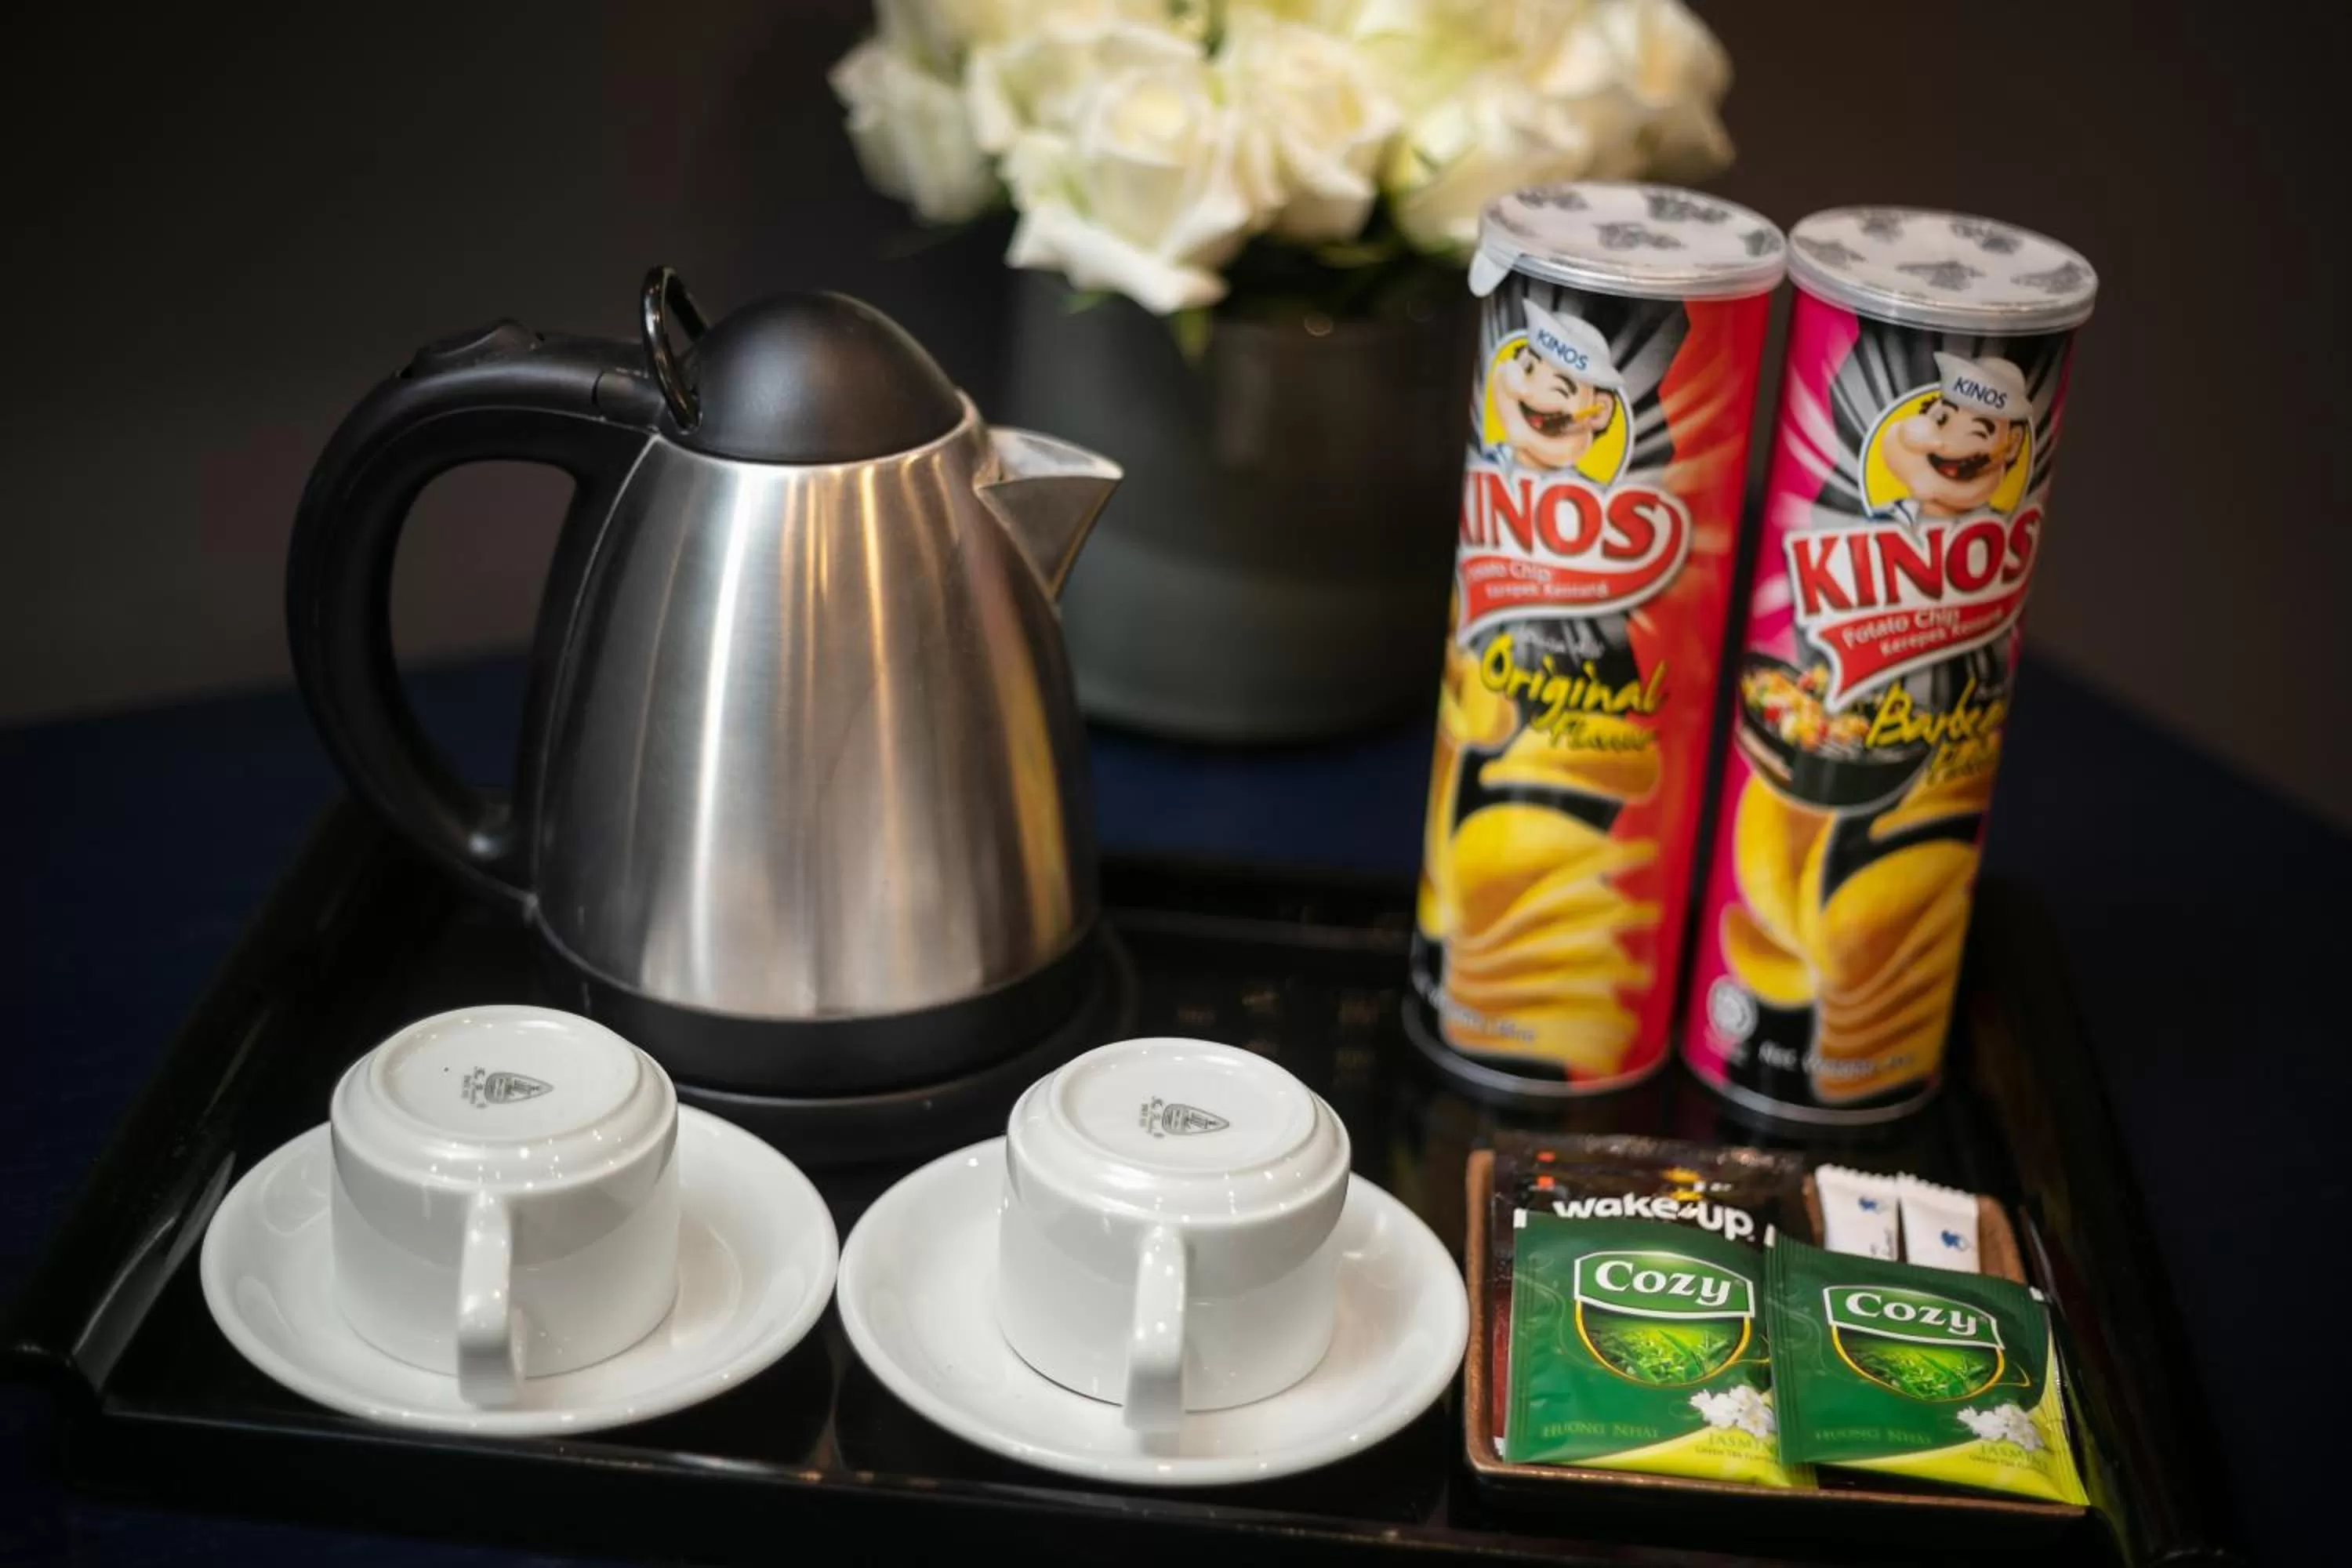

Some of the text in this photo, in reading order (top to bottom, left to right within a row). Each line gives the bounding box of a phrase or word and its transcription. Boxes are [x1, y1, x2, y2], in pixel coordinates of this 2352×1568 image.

[1536, 327, 1589, 372] KINOS
[1952, 376, 2009, 410] KINOS
[1459, 470, 1668, 561] INOS
[1791, 506, 2043, 616] KINOS
[1480, 632, 1668, 730] Original
[1594, 1259, 1732, 1307] Cozy
[1845, 1291, 1977, 1337] Cozy
